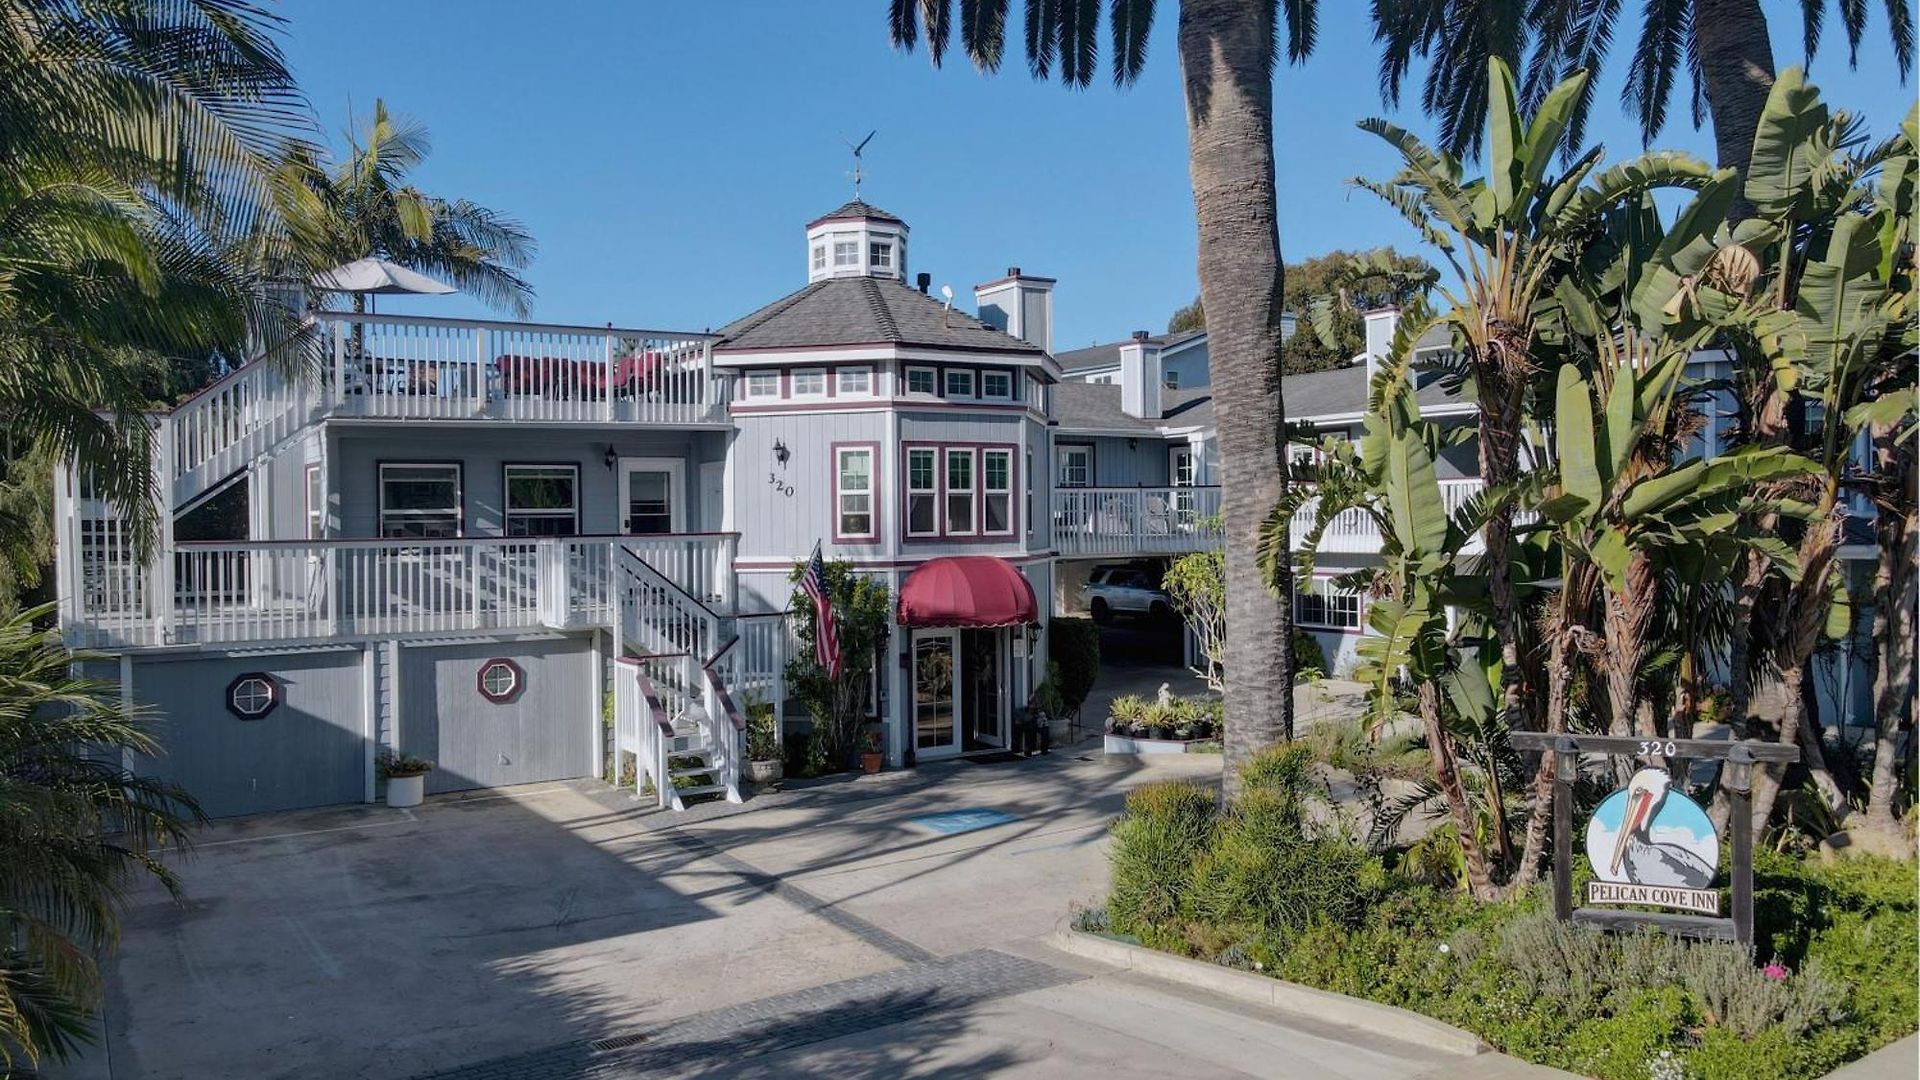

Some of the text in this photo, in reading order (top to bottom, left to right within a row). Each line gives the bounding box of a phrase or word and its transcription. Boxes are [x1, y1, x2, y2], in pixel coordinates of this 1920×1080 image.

[768, 473, 794, 497] 320
[1637, 741, 1676, 756] 320
[1591, 884, 1715, 910] PELICAN COVE INN
